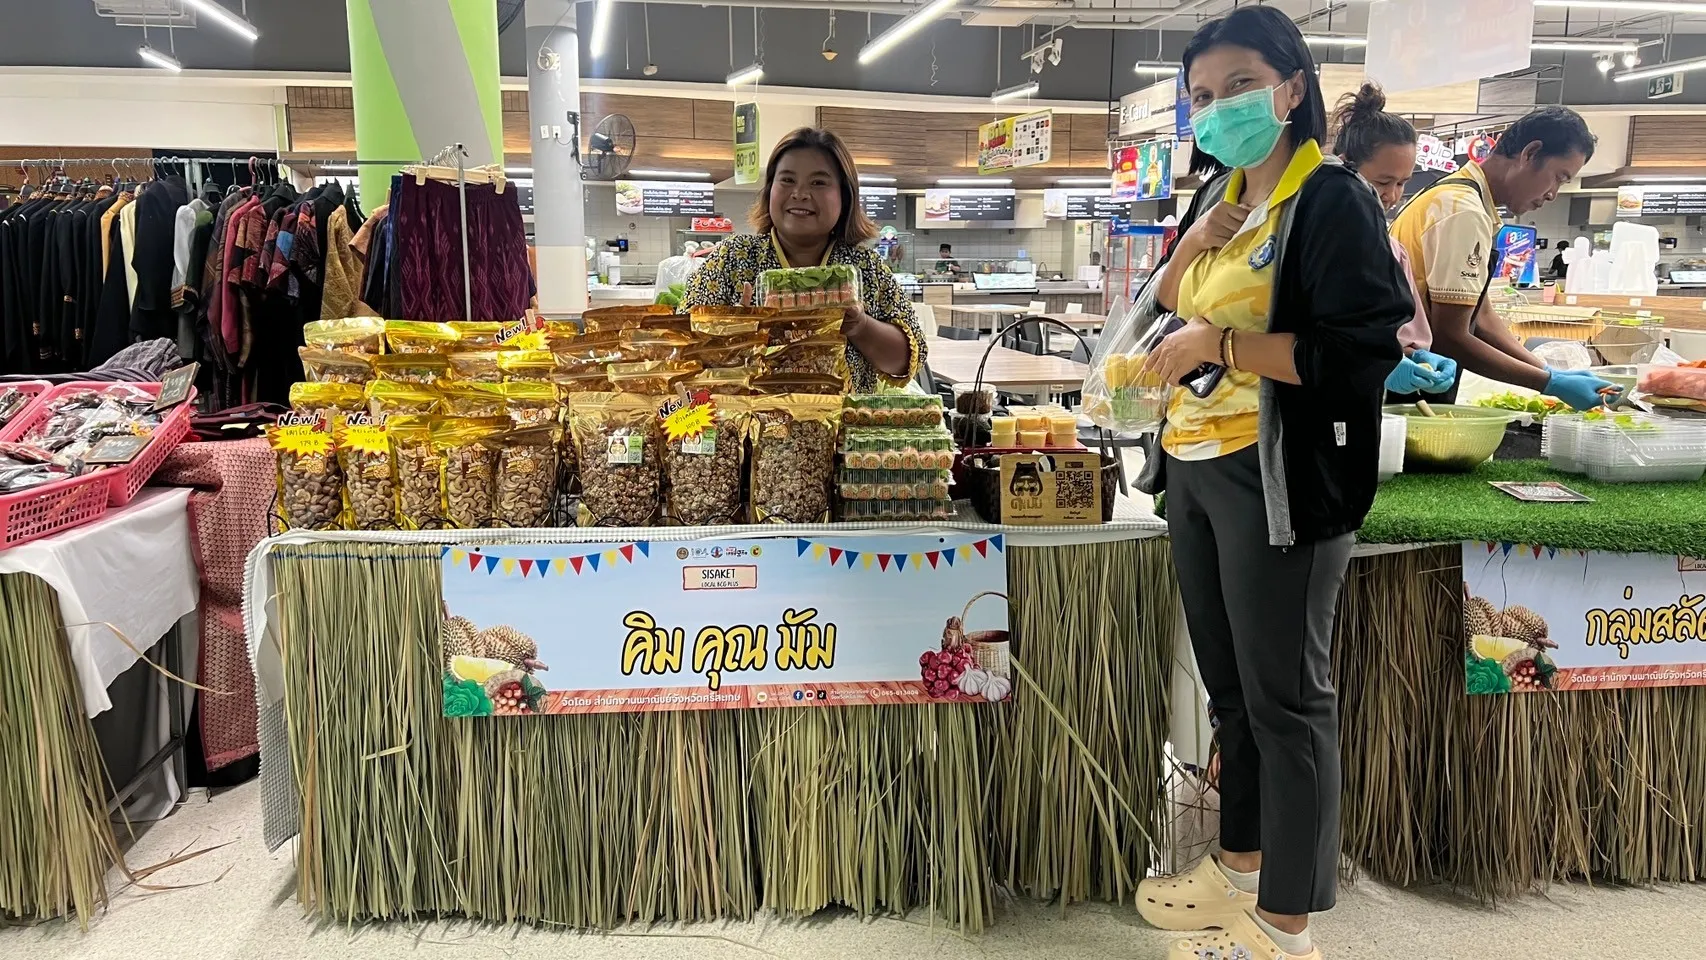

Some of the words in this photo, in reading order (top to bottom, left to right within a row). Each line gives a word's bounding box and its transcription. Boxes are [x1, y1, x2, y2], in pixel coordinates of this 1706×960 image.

[1121, 98, 1150, 124] E-Card
[495, 318, 527, 343] New!
[278, 412, 319, 426] New!
[702, 569, 735, 579] SISAKET
[621, 610, 685, 676] คิม
[692, 623, 768, 691] คุณ
[775, 607, 837, 671] มัม
[1571, 673, 1598, 683] จัดโดย
[562, 696, 592, 707] จัดโดย
[594, 692, 741, 706] สำนักงานพาณิชย์จังหวัดศรีสะเกษ
